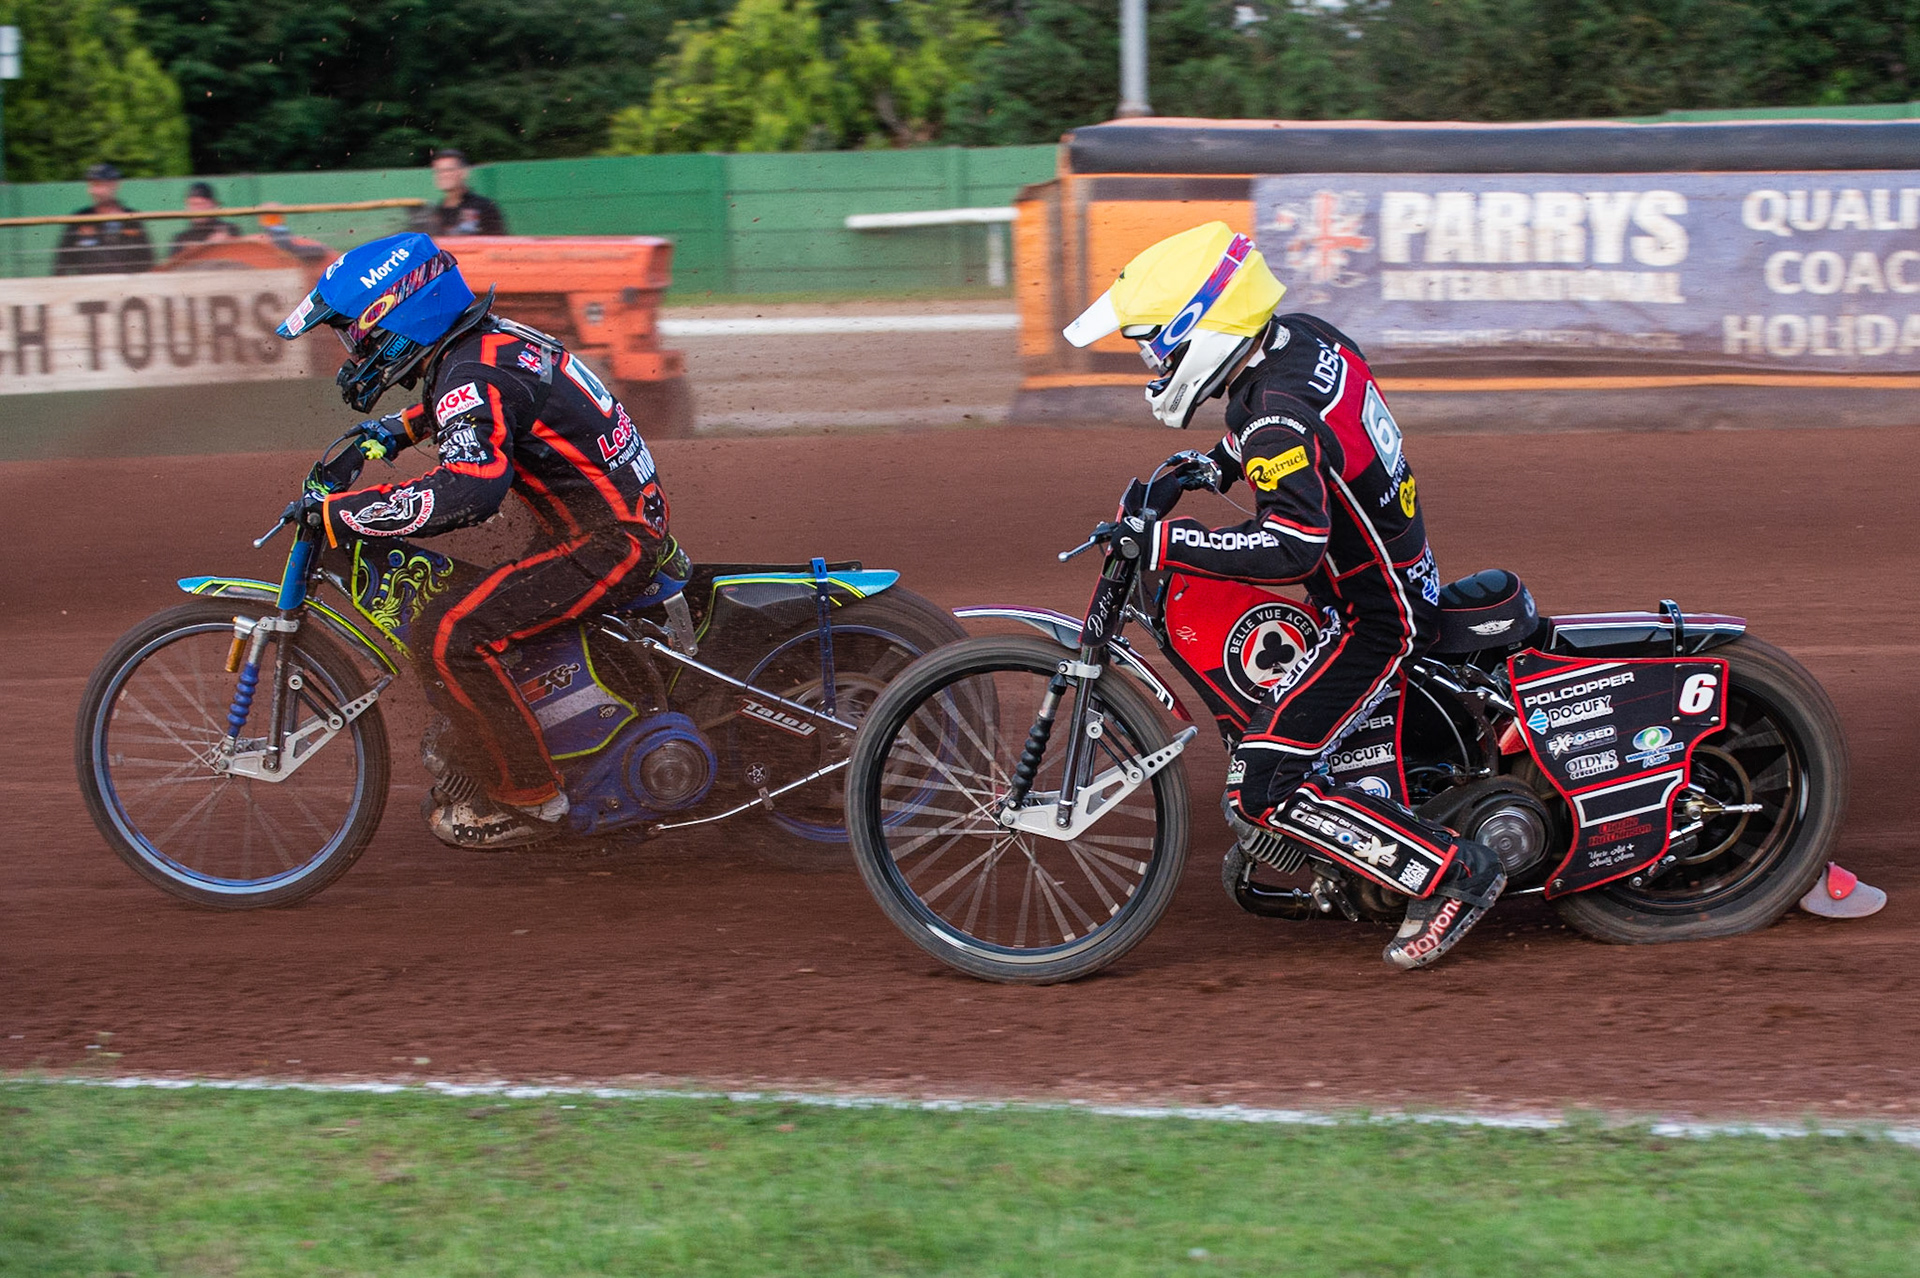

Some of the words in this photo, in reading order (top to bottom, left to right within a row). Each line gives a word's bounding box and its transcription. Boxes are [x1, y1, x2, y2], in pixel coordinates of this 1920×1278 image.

[1379, 190, 1690, 266] PARRYS
[1741, 189, 1920, 237] QUALI
[360, 248, 410, 289] Morris
[1764, 250, 1920, 294] COAC
[75, 291, 285, 370] TOURS
[571, 357, 612, 402] 4
[1368, 401, 1395, 455] 6
[1248, 451, 1307, 485] Rentruck
[362, 525, 416, 537] SPEEDWAY
[414, 490, 434, 529] MUSEUM
[1229, 617, 1257, 655] BELLE
[1255, 609, 1282, 622] VUE
[1285, 612, 1314, 637] ACES
[1523, 671, 1635, 708] POLCOPPER
[1549, 695, 1612, 722] DOCUFY
[1678, 673, 1718, 715] 6
[1330, 742, 1394, 768] DOCUFY
[1548, 726, 1615, 757] EXPOSED
[1566, 750, 1617, 772] OLDY'S
[1290, 808, 1398, 867] EXPOSED
